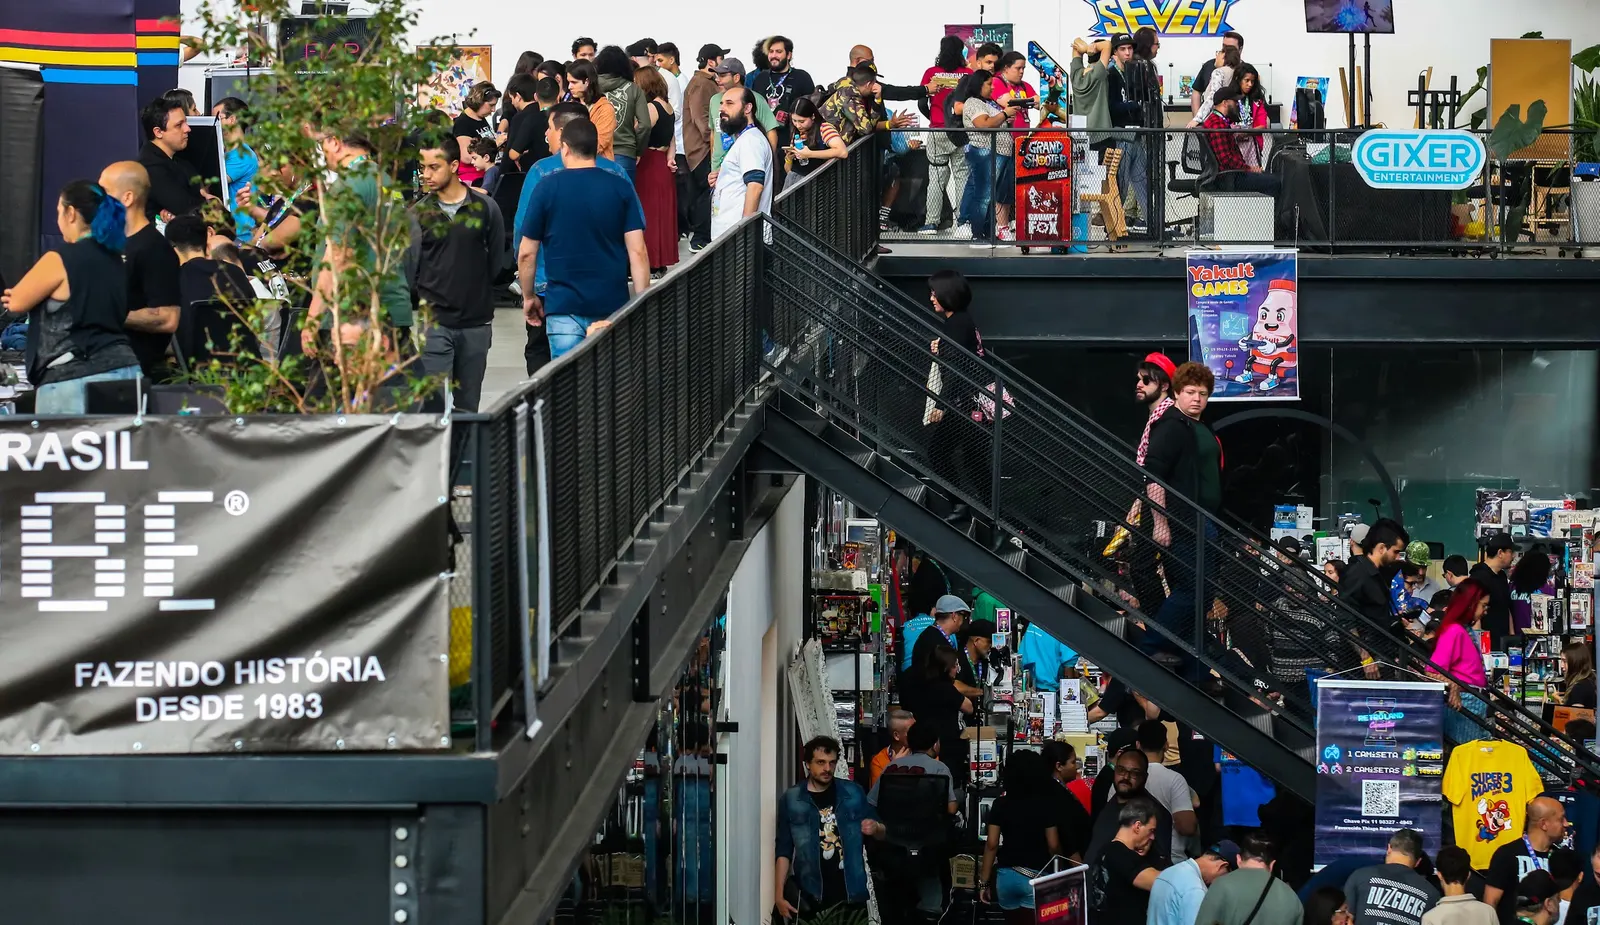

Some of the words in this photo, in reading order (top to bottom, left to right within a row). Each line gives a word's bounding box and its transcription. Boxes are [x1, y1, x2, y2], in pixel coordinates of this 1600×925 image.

[1097, 0, 1227, 34] SEVEN
[973, 28, 1008, 46] Belief
[1028, 140, 1064, 154] GRAND
[1367, 139, 1471, 168] GIXER
[1023, 153, 1068, 170] SHOOTER
[1373, 172, 1466, 183] ENTERTAINMENT
[1028, 213, 1058, 221] GRUMPY
[1028, 221, 1058, 236] FOX
[1189, 263, 1255, 281] Yakult
[1191, 279, 1249, 297] GAMES
[0, 431, 149, 471] RASIL
[75, 662, 225, 688] FAZENDO
[235, 650, 385, 684] HISTÓRIA
[136, 696, 244, 722] DESDE
[254, 693, 323, 720] 1983
[1471, 772, 1503, 788] SUPER
[1502, 772, 1513, 794] 3
[1471, 780, 1503, 802] MARIO
[1366, 886, 1427, 918] BUZZCOCKS
